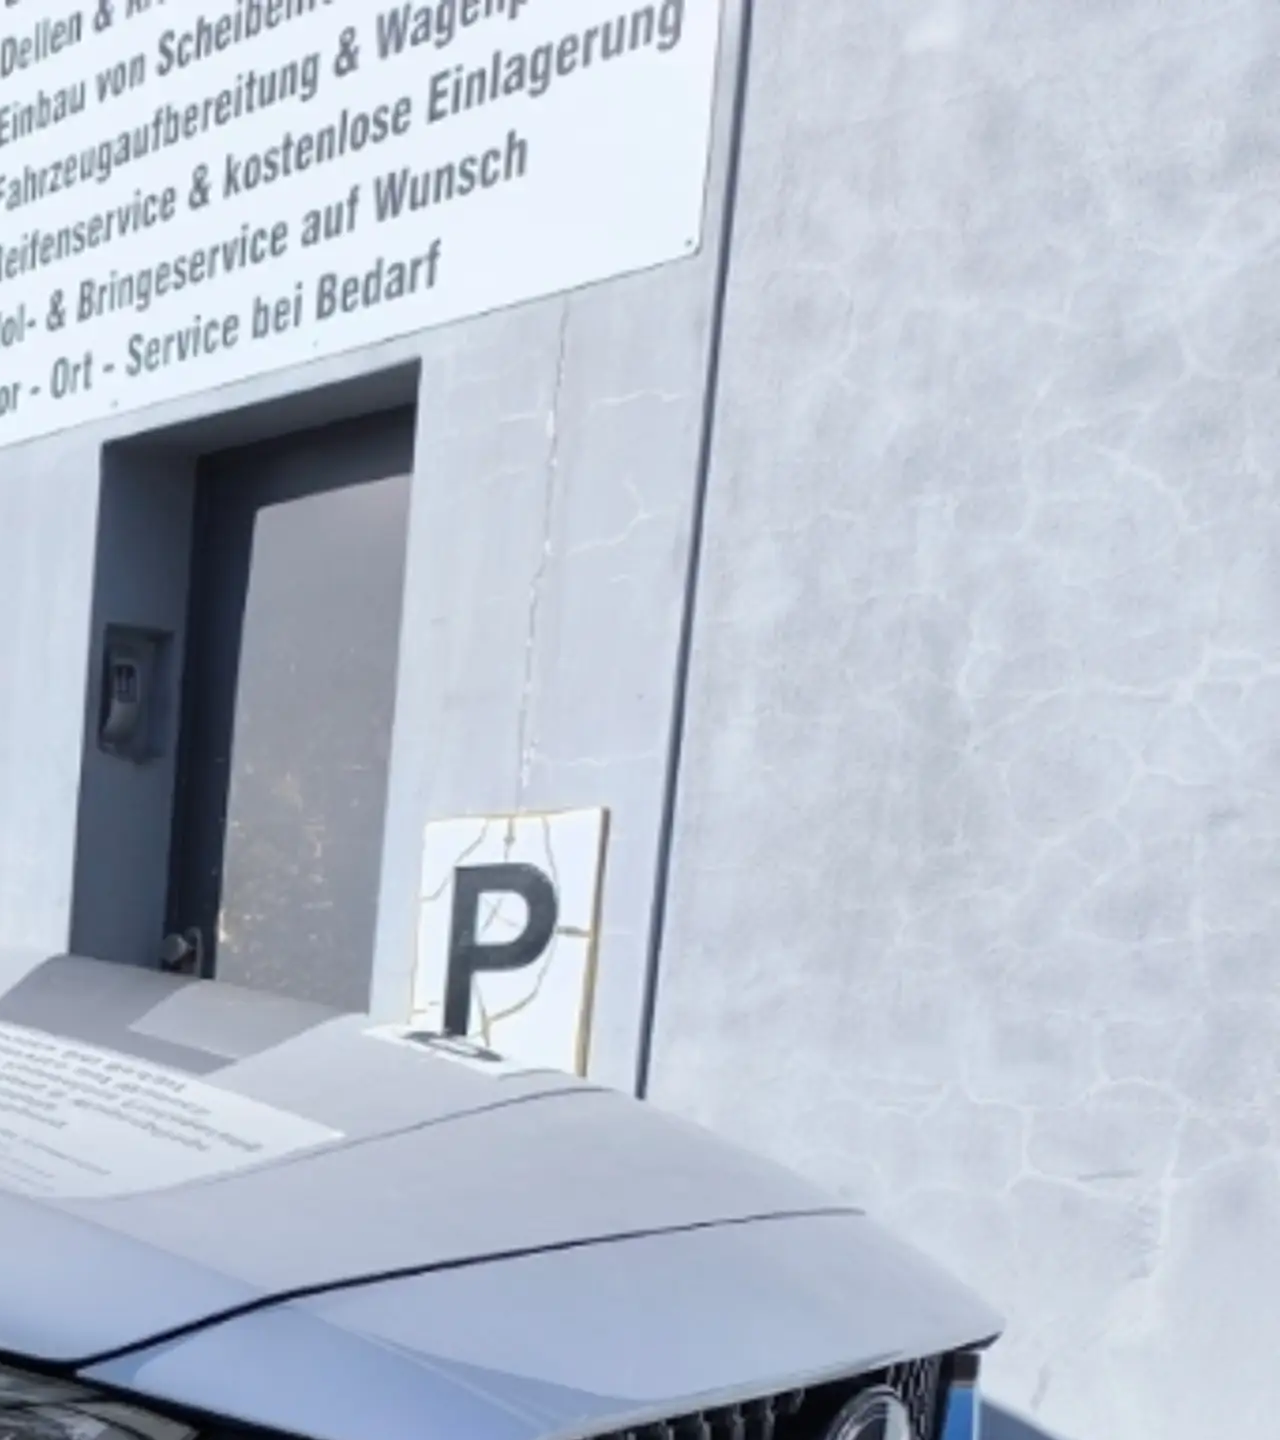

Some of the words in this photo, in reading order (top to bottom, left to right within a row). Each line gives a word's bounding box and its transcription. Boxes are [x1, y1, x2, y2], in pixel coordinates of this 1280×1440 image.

[0, 10, 82, 79] Dellen
[96, 52, 147, 103] von
[188, 163, 210, 209] &
[223, 96, 413, 199] kostenlose
[427, 0, 685, 123] Einlagerung
[333, 26, 360, 77] &
[46, 289, 66, 331] &
[77, 218, 289, 323] Bringeservice
[301, 185, 361, 248] auf
[374, 128, 529, 223] Wunsch
[50, 350, 93, 400] Ort
[125, 313, 240, 377] Service
[251, 282, 303, 341] bei
[316, 238, 442, 321] Bedarf
[443, 862, 559, 1037] P
